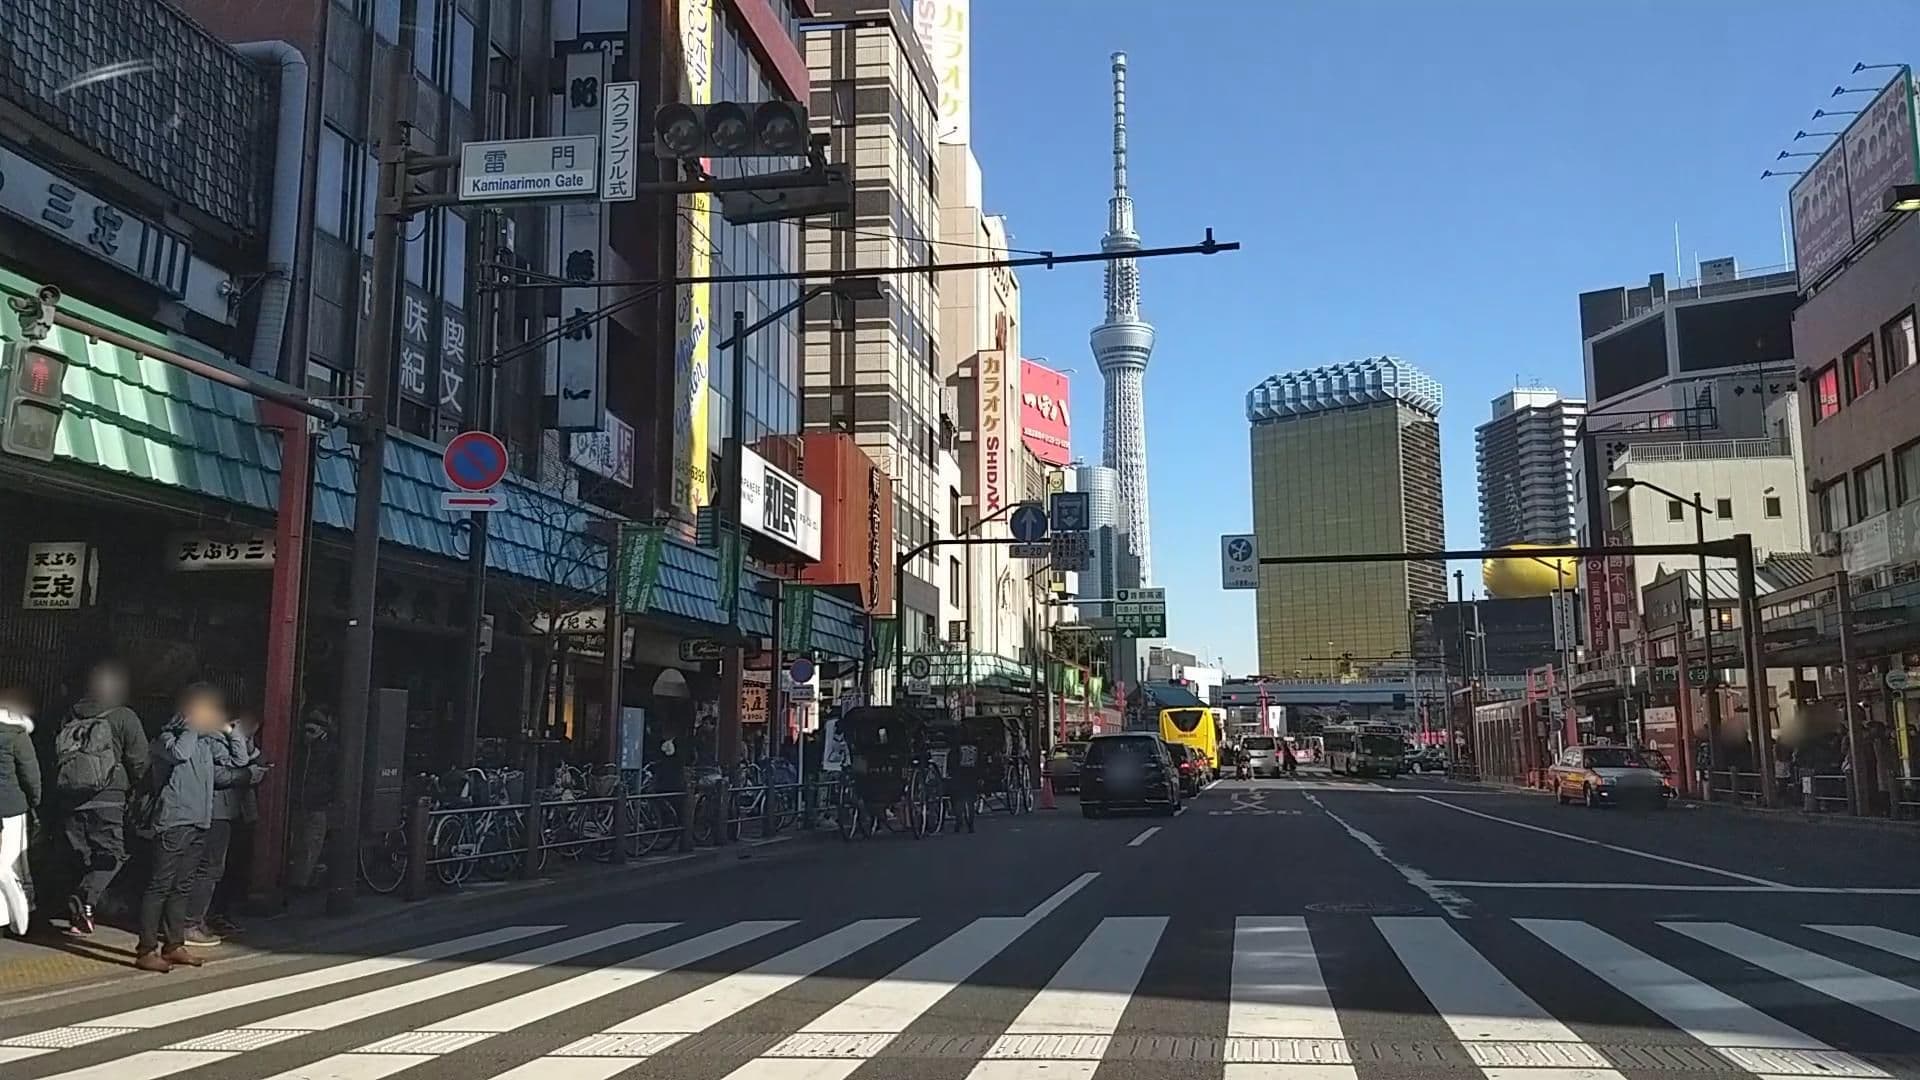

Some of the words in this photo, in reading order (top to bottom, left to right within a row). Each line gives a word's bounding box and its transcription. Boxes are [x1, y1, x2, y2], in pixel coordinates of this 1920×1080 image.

[937, 4, 964, 117] カラオケ
[484, 146, 575, 173] 雷門
[609, 88, 630, 196] スクランブル式
[43, 183, 123, 255] 三定
[472, 177, 550, 192] Kaminarimon
[555, 174, 584, 188] Gate
[984, 357, 1000, 432] カラオケ
[765, 474, 797, 537] 和民
[986, 437, 1000, 511] SHIDAX
[29, 573, 75, 598] 三定
